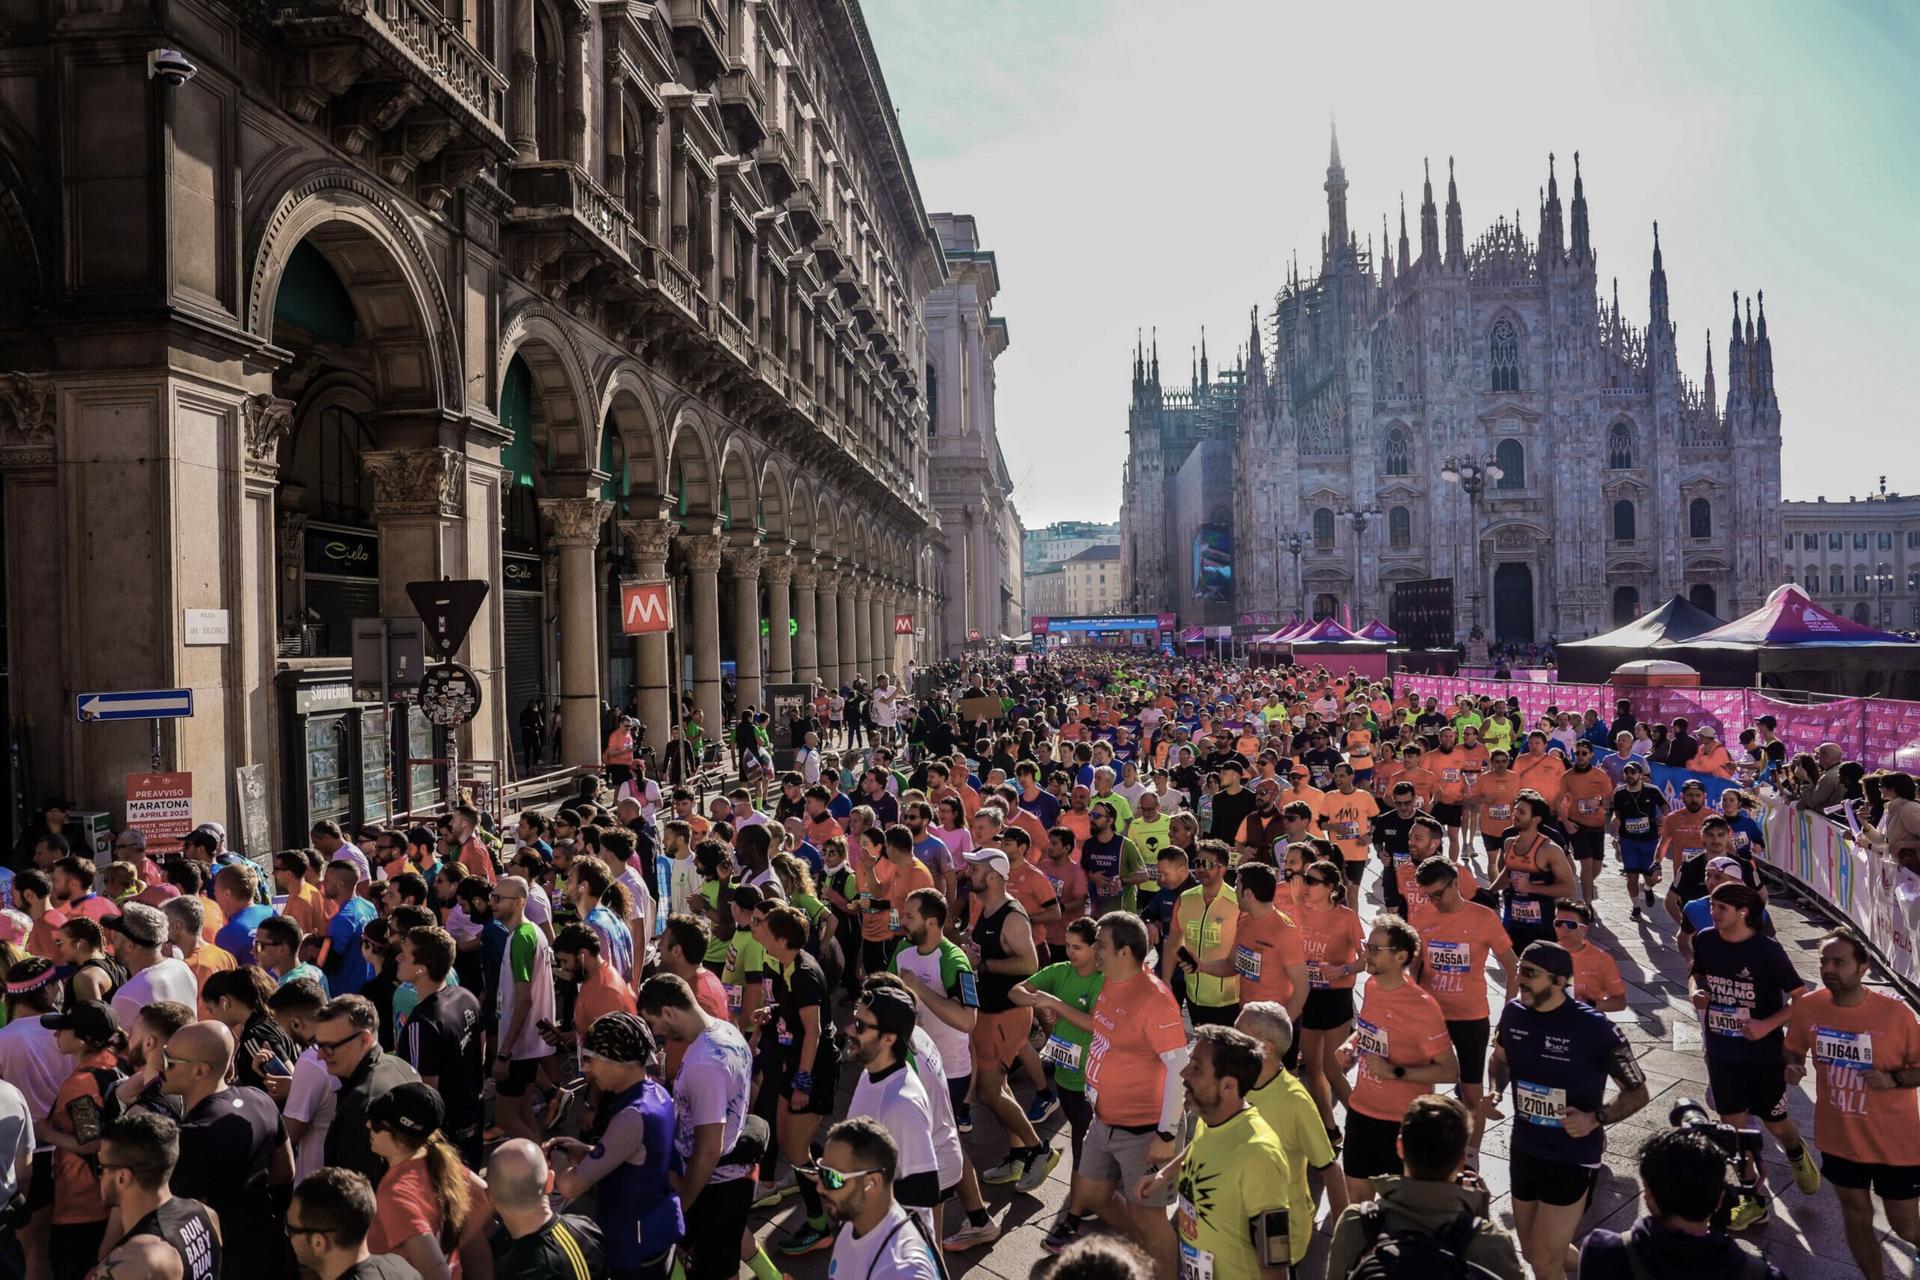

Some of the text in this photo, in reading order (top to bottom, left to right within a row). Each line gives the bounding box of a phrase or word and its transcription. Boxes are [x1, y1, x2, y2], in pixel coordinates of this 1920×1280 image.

[324, 541, 369, 561] Cielo
[504, 563, 532, 579] Cielo
[626, 593, 667, 625] M
[896, 617, 913, 631] M
[310, 683, 350, 700] SOUVENIR
[135, 789, 184, 798] PREAVVISO
[129, 800, 189, 811] MARATONA
[138, 811, 168, 819] APRILE
[158, 820, 189, 828] MODIFICHE
[1090, 854, 1117, 862] RUNNING
[1515, 906, 1535, 918] 1248A
[1433, 950, 1463, 966] 2455A
[1709, 983, 1756, 1000] YNAMO
[1734, 981, 1754, 990] PER
[1357, 1031, 1382, 1055] 2457A
[1826, 1042, 1860, 1061] 1164A
[1051, 1045, 1073, 1066] 1407A
[1524, 1097, 1555, 1118] 2701A
[179, 1215, 205, 1246] RUN
[185, 1230, 211, 1266] BABY
[192, 1250, 212, 1280] RUN
